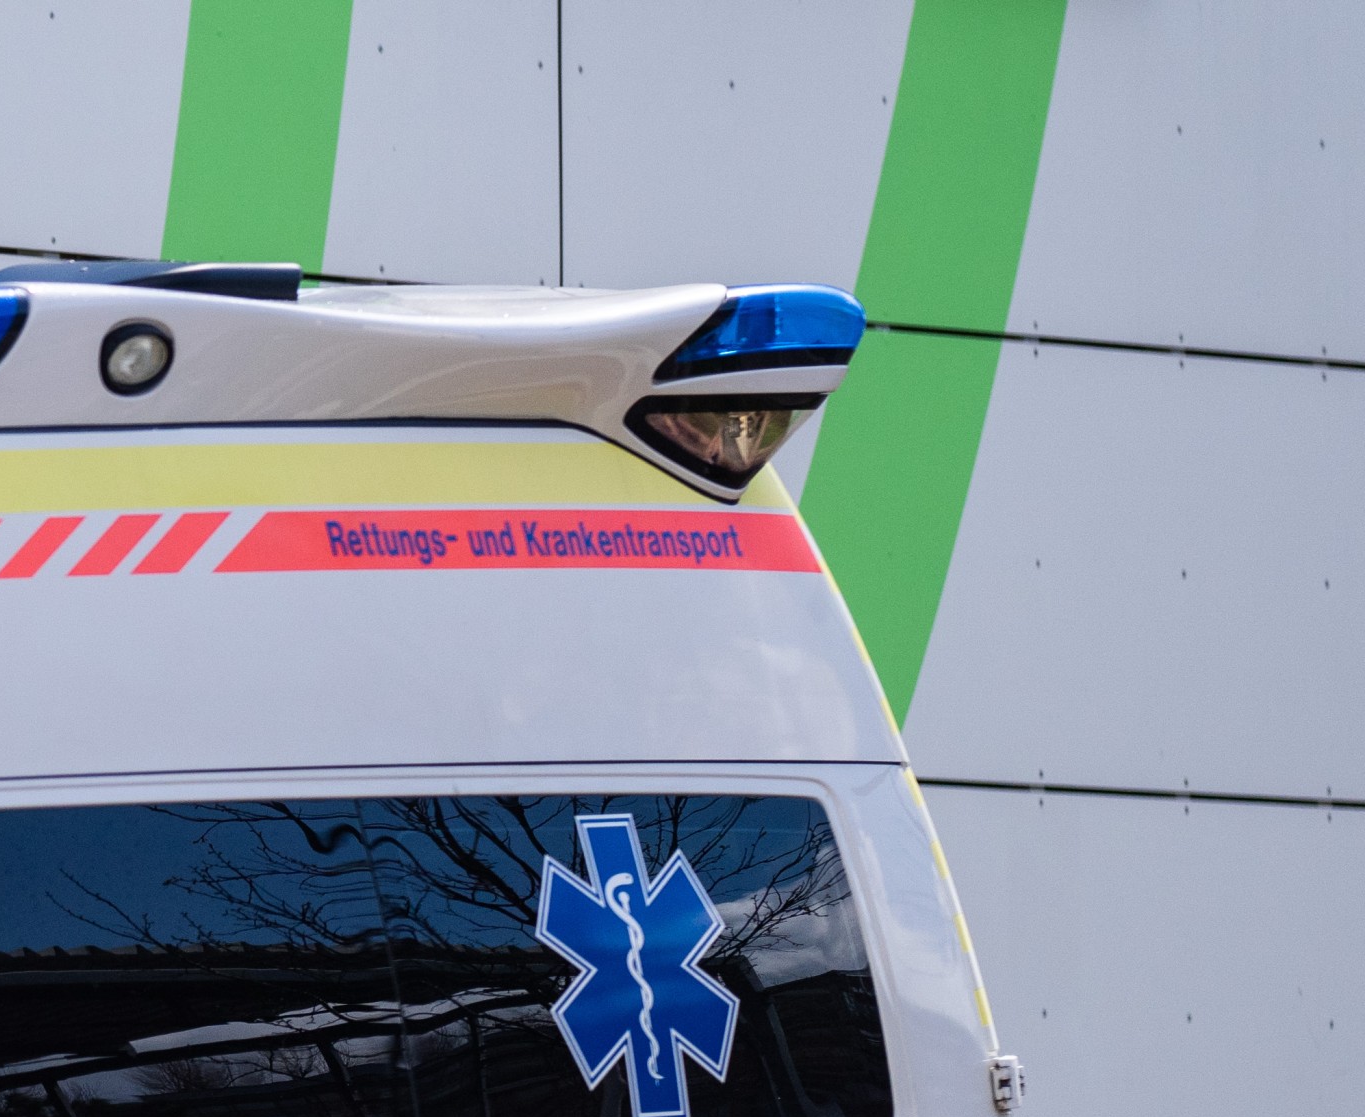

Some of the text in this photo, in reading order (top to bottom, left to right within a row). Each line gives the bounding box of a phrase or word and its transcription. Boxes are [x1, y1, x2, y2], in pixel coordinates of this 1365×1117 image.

[325, 520, 743, 565] Rettungs- und Krankentransport
